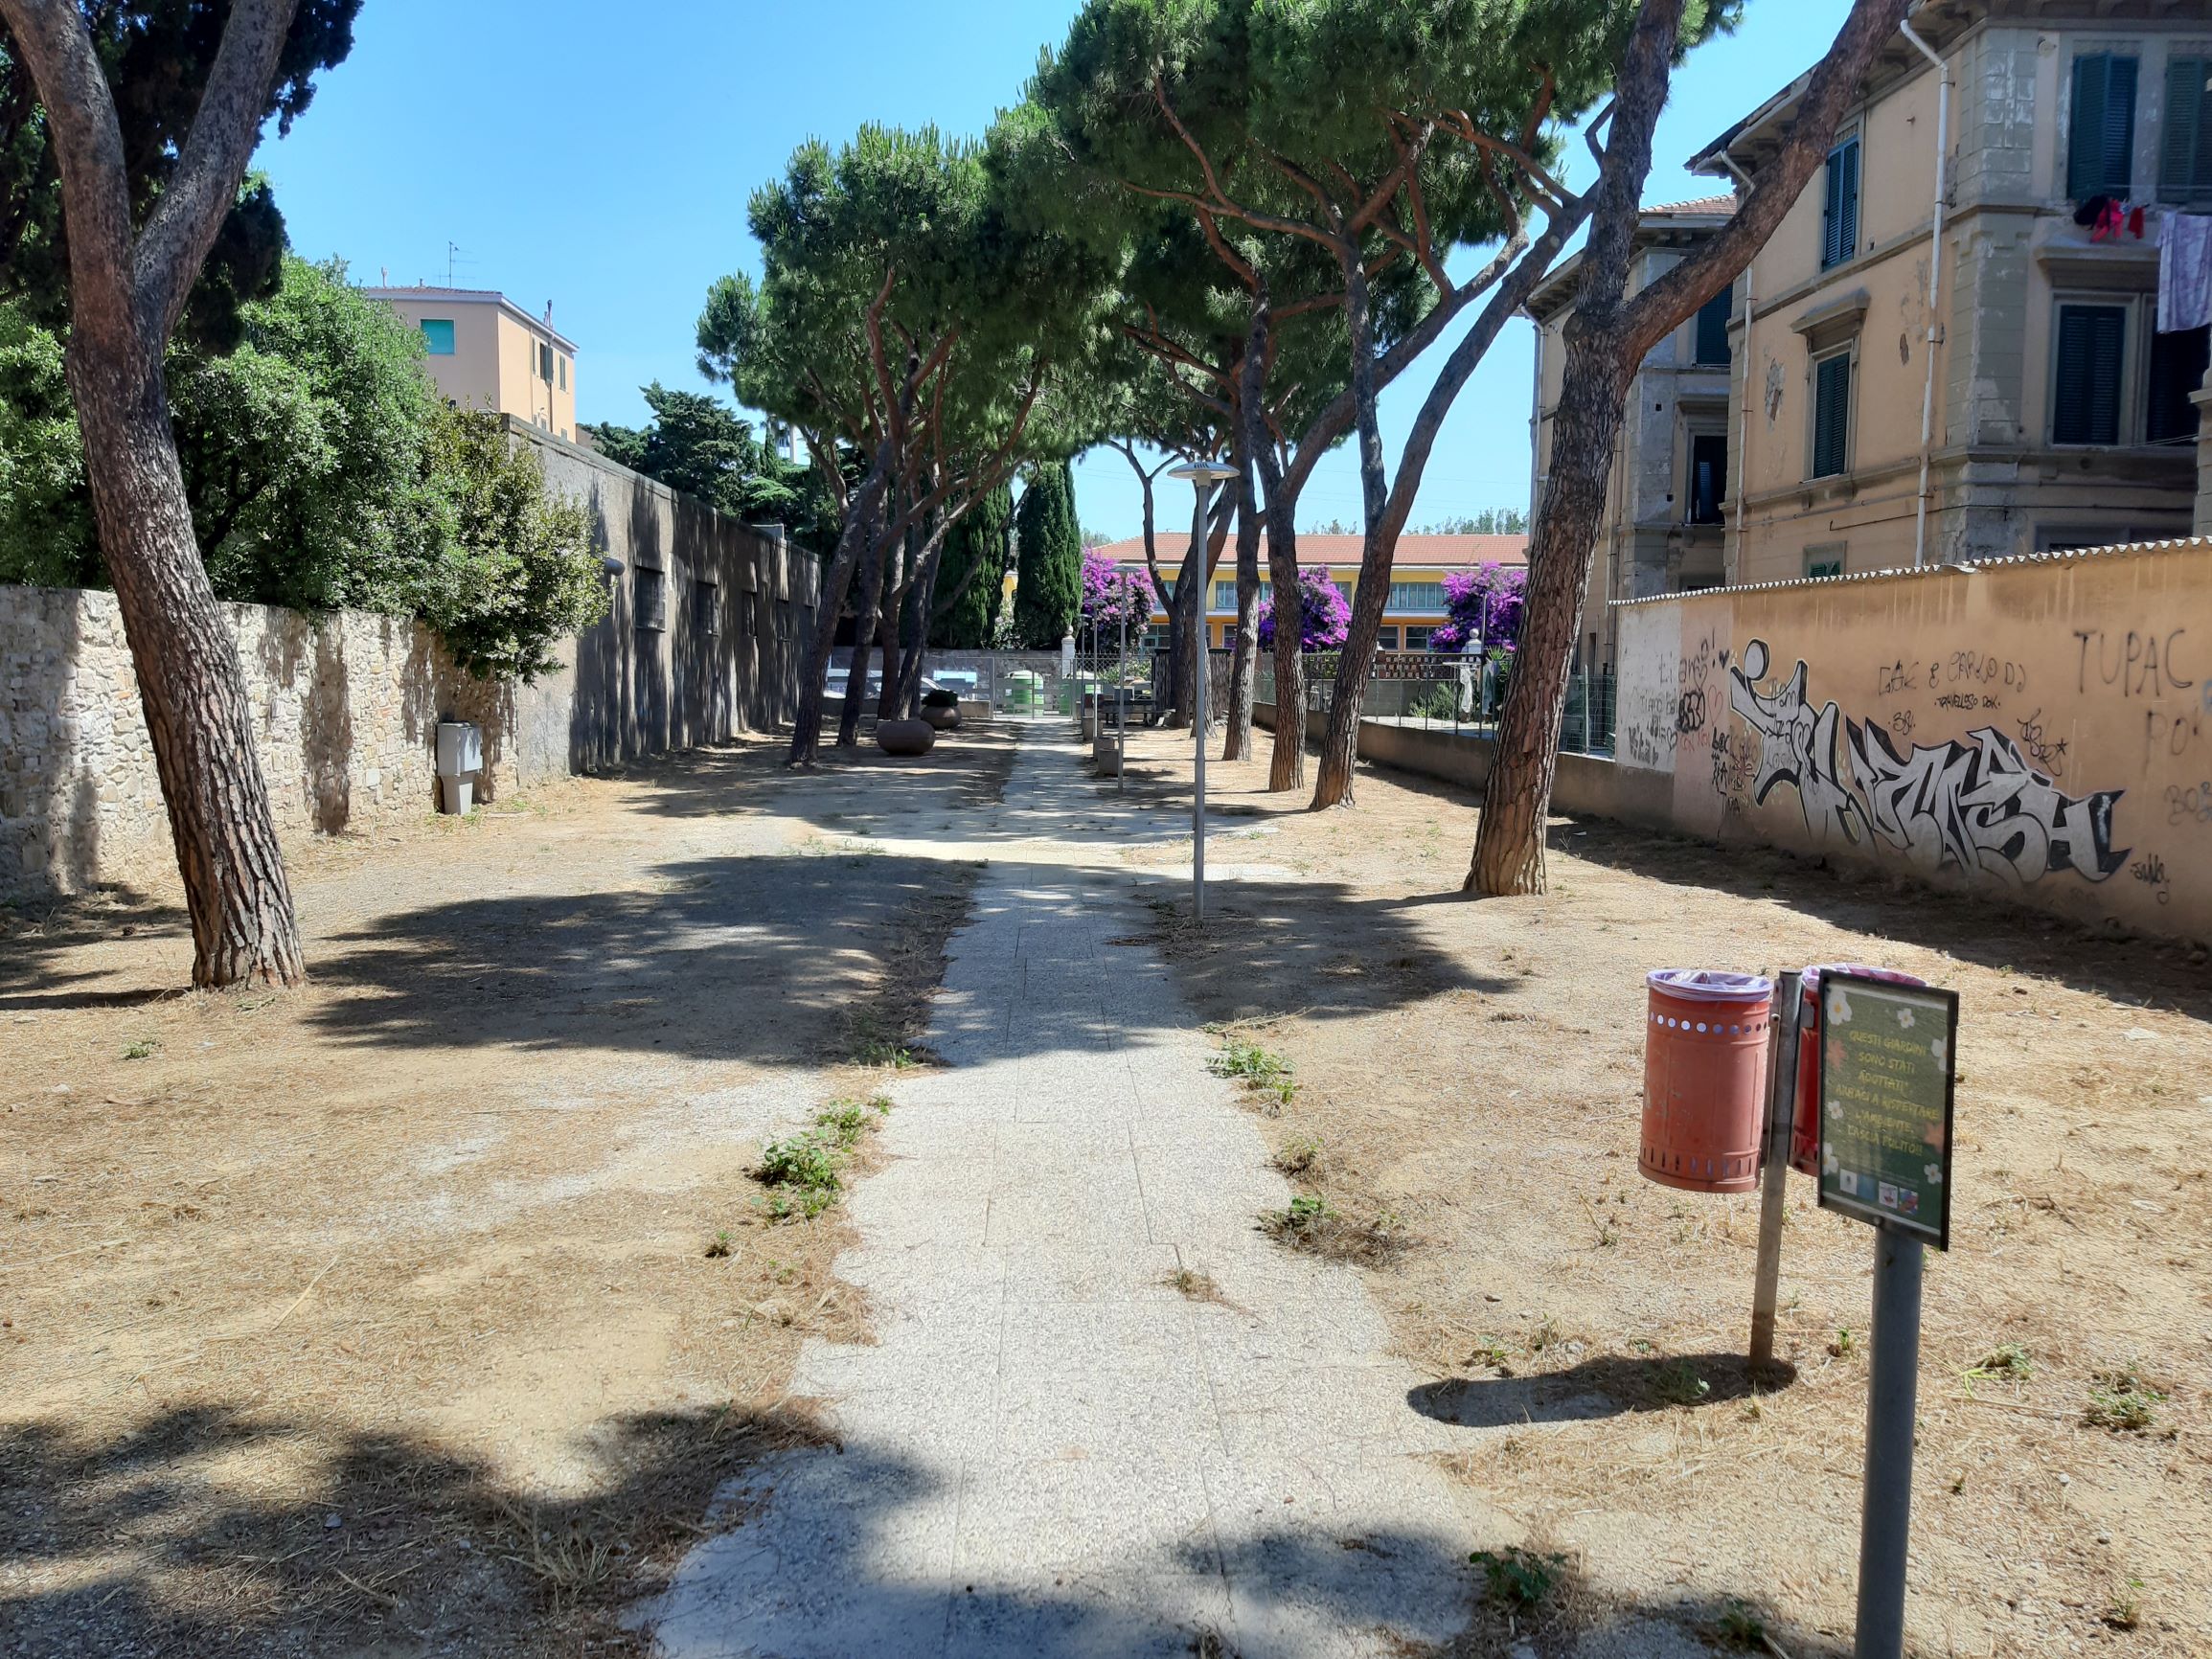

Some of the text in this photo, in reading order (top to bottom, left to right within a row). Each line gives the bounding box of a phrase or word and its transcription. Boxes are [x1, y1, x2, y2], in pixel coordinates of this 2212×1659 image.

[2072, 627, 2194, 697] TUPAC
[1849, 1030, 1927, 1057] QUESTI GIARDINI
[1858, 1051, 1916, 1075] SONO STATI
[1872, 1093, 1879, 1105] A
[1847, 1124, 1880, 1146] LASCIA
